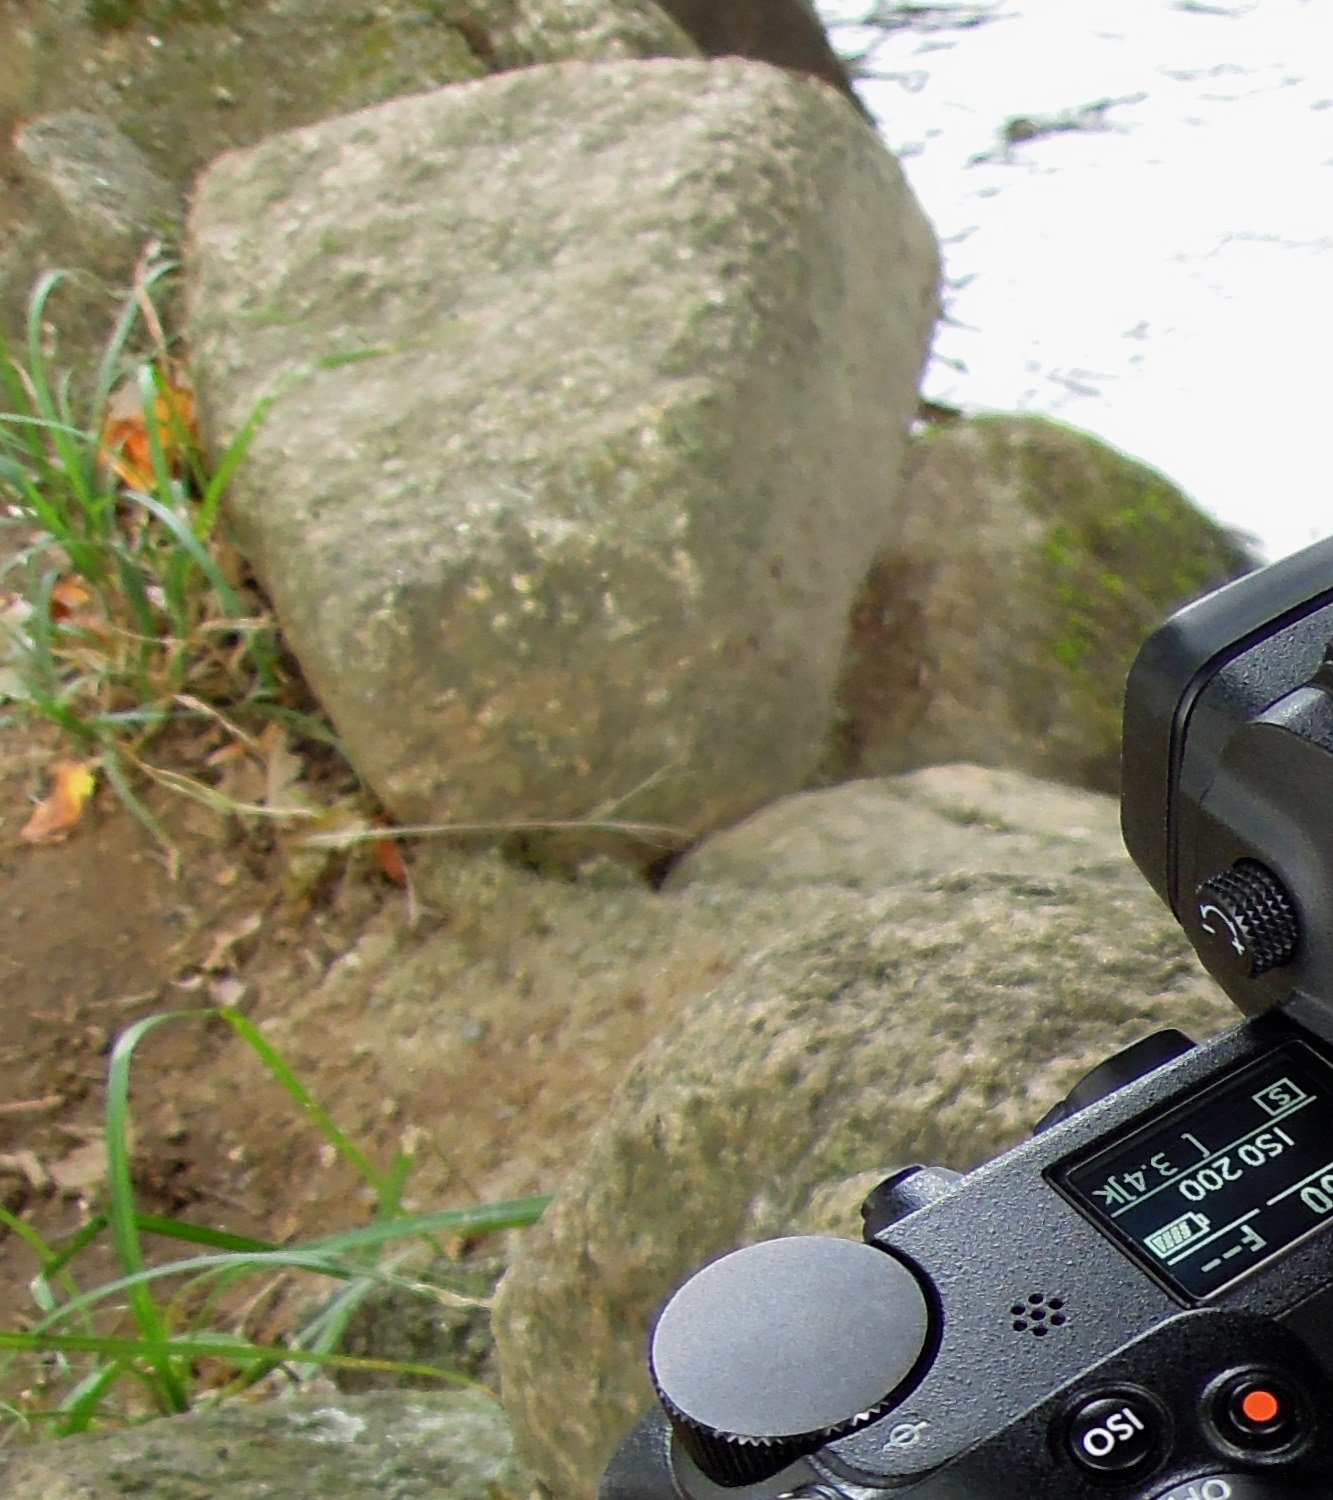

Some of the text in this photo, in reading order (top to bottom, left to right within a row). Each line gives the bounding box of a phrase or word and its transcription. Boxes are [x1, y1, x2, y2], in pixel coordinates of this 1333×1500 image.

[1178, 1126, 1295, 1202] ISO 200
[1082, 1407, 1145, 1457] ISO
